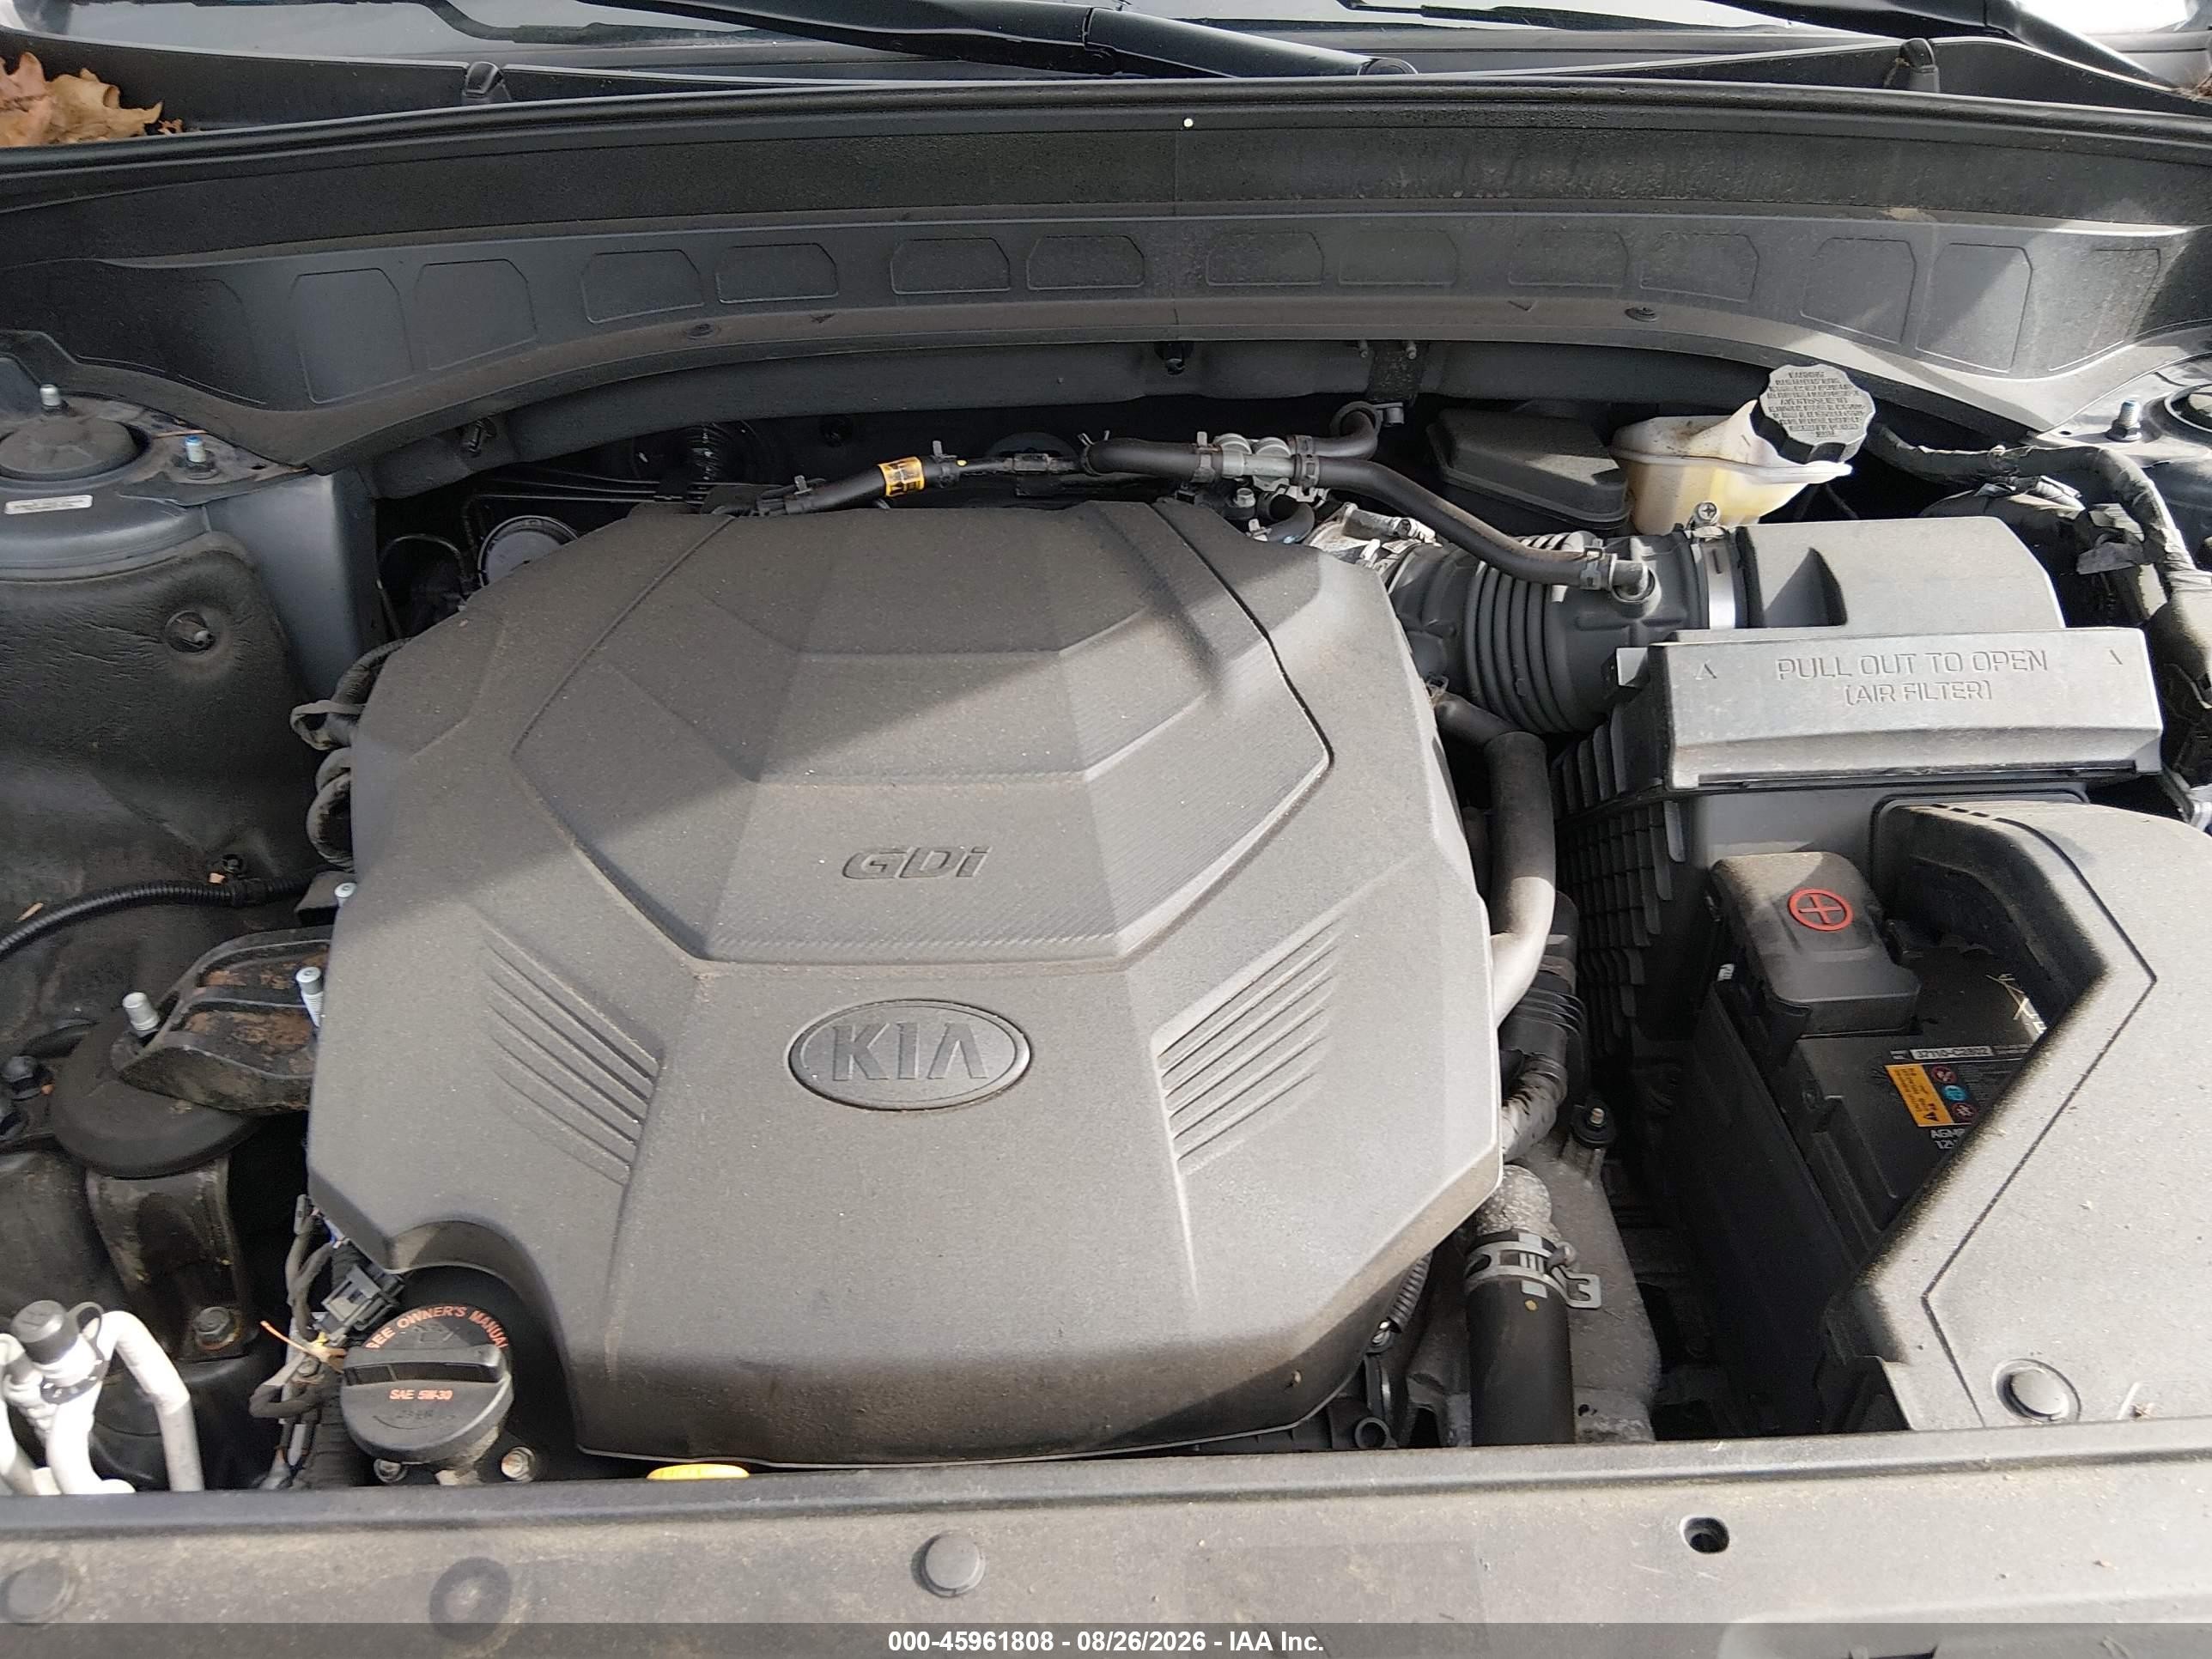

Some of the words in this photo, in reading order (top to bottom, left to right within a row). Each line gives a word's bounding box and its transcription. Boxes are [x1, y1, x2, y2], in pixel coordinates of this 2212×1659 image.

[1777, 657, 1853, 680] PULL
[1860, 653, 1917, 676] OUT
[1924, 651, 1965, 672] TO
[1972, 649, 2049, 672] OPEN
[831, 1022, 988, 1082] KIA
[365, 1327, 396, 1349] SEE
[396, 1305, 467, 1328] OWNER'S
[389, 1389, 415, 1400] SAE
